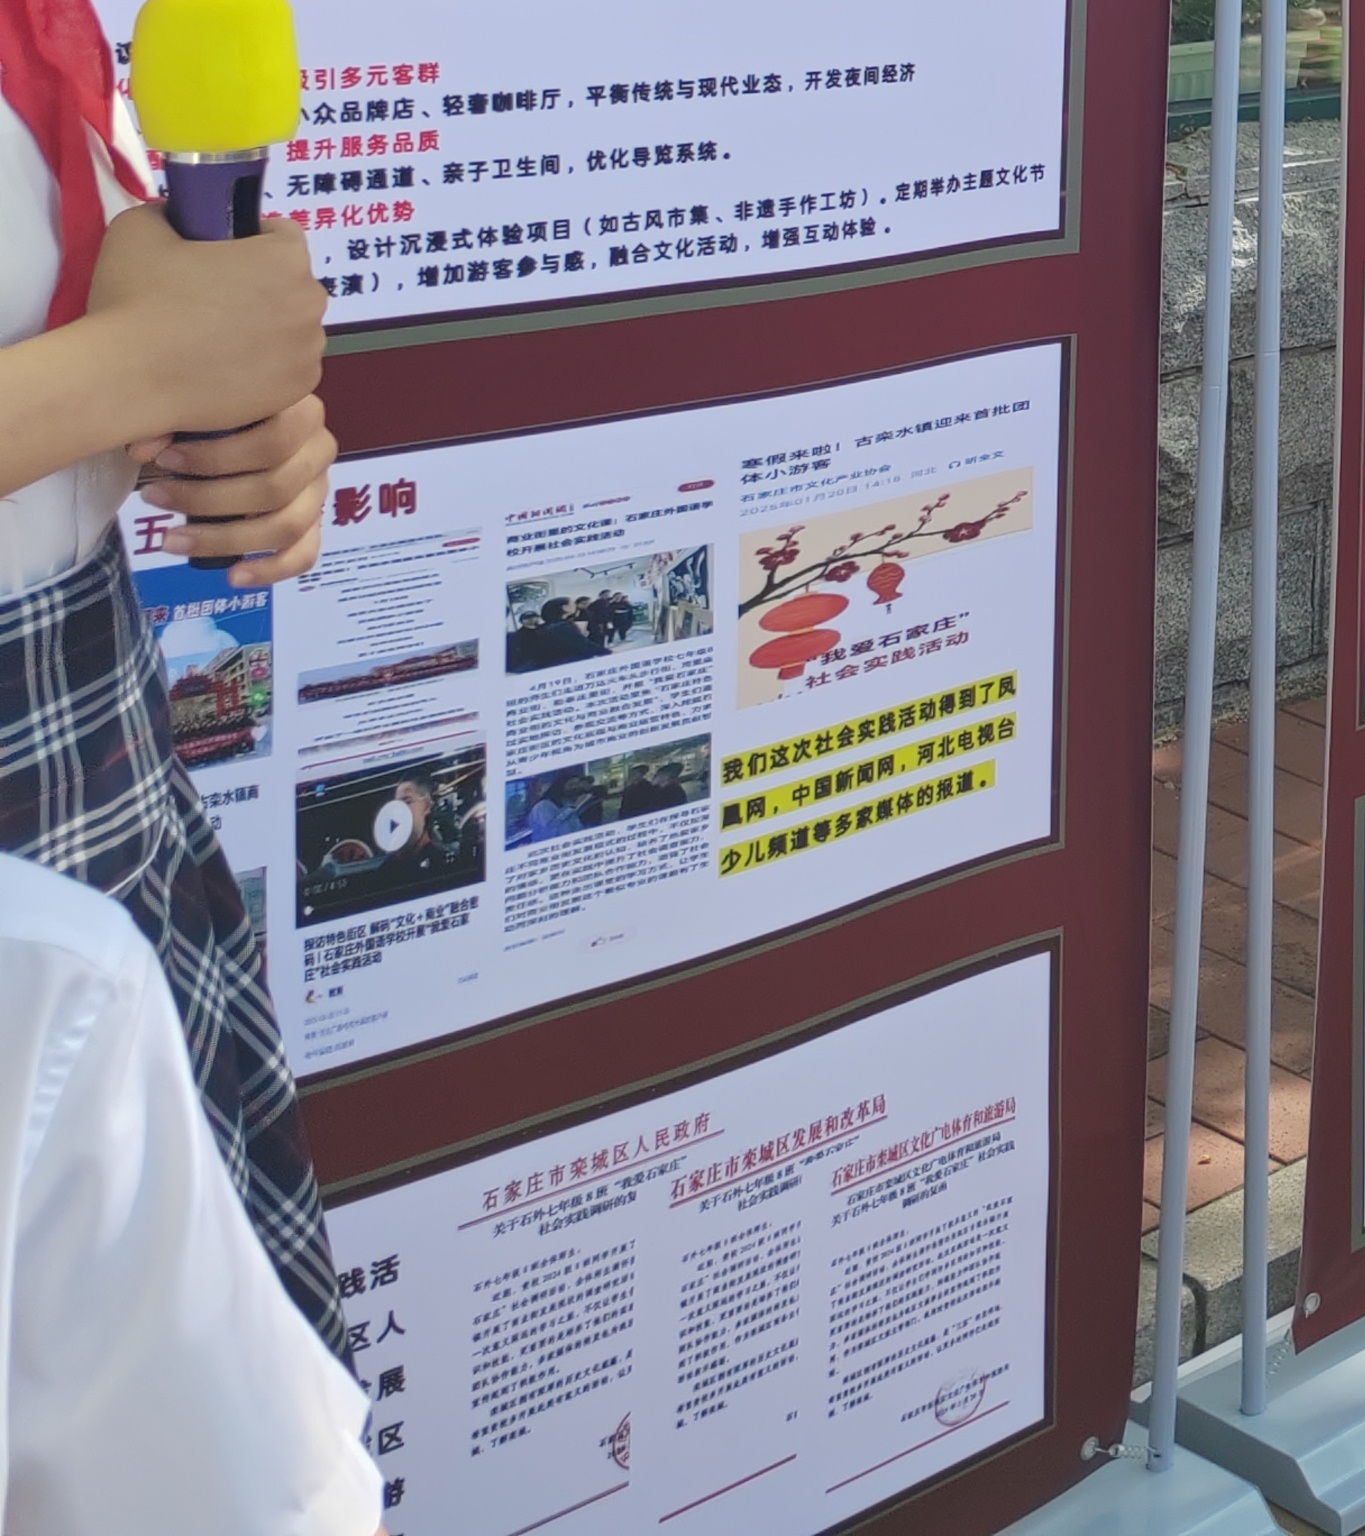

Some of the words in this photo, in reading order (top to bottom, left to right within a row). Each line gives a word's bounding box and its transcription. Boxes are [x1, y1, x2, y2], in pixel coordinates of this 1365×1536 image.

[262, 199, 416, 233] 差异化优势
[740, 458, 831, 486] 体小游客
[804, 630, 970, 691] 社会实践活动
[722, 674, 1017, 785] 我们这次社会实践活动得到了凤
[720, 769, 988, 876] 少儿频道等多家媒体的报道。
[482, 1112, 711, 1212] 石家庄市栾城区人民政府
[669, 1093, 887, 1200] 石家庄市栾城区发展和改革局
